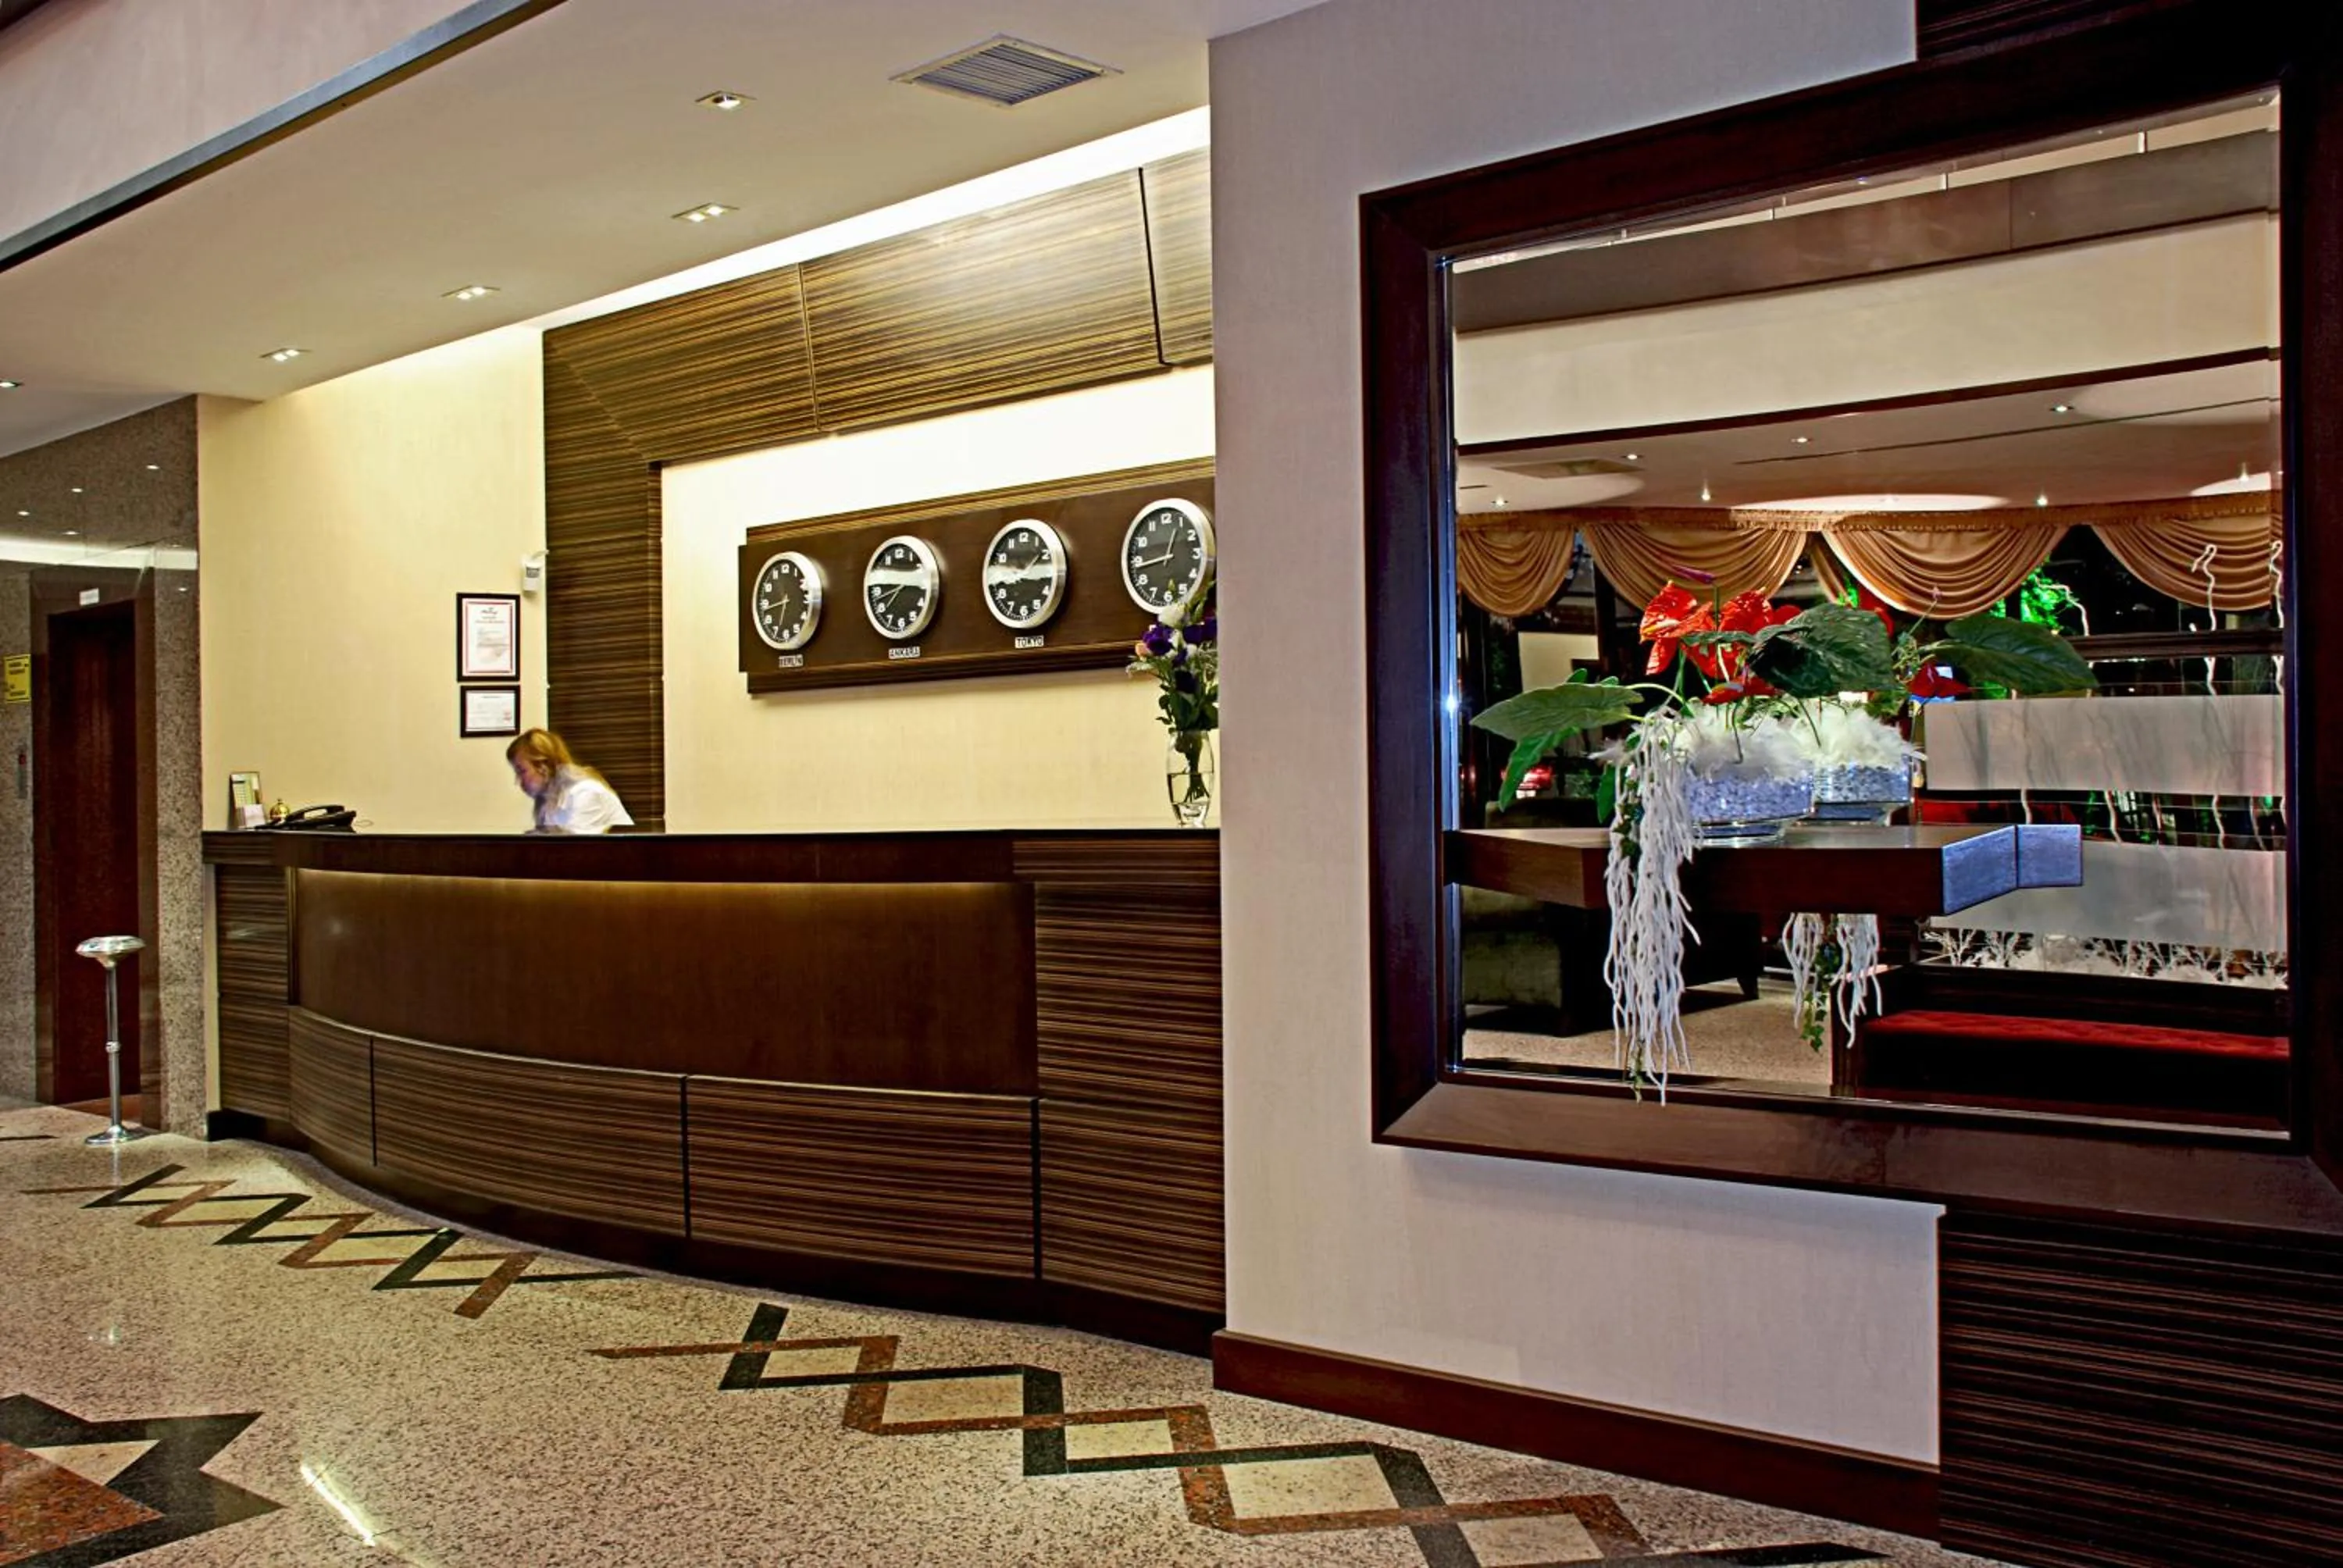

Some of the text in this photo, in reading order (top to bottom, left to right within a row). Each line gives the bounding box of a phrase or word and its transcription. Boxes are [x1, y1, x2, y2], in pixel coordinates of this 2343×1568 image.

[1161, 513, 1172, 525] 12
[1179, 516, 1183, 528] 1
[1148, 521, 1156, 532] 11
[1018, 533, 1029, 543] 12
[1187, 529, 1196, 541] 2
[1008, 538, 1015, 549] 11
[1136, 536, 1147, 547] 10
[1042, 550, 1050, 560] 2
[1192, 547, 1200, 559] 3
[1133, 556, 1143, 568] 9
[1189, 568, 1197, 578] 4
[1139, 574, 1148, 585] 8
[1042, 586, 1049, 595] 4
[1150, 587, 1157, 600] 7
[1179, 583, 1187, 593] 5
[998, 589, 1007, 599] 8
[1164, 591, 1172, 602] 6
[917, 597, 925, 607] 4
[1007, 600, 1015, 612] 7
[1033, 600, 1041, 609] 5
[801, 611, 807, 620] 4
[909, 611, 917, 621] 5
[1020, 605, 1028, 616] 6
[886, 615, 893, 627] 7
[897, 618, 905, 628] 6
[772, 625, 779, 637] 7
[793, 623, 800, 633] 5
[783, 629, 790, 640] 6
